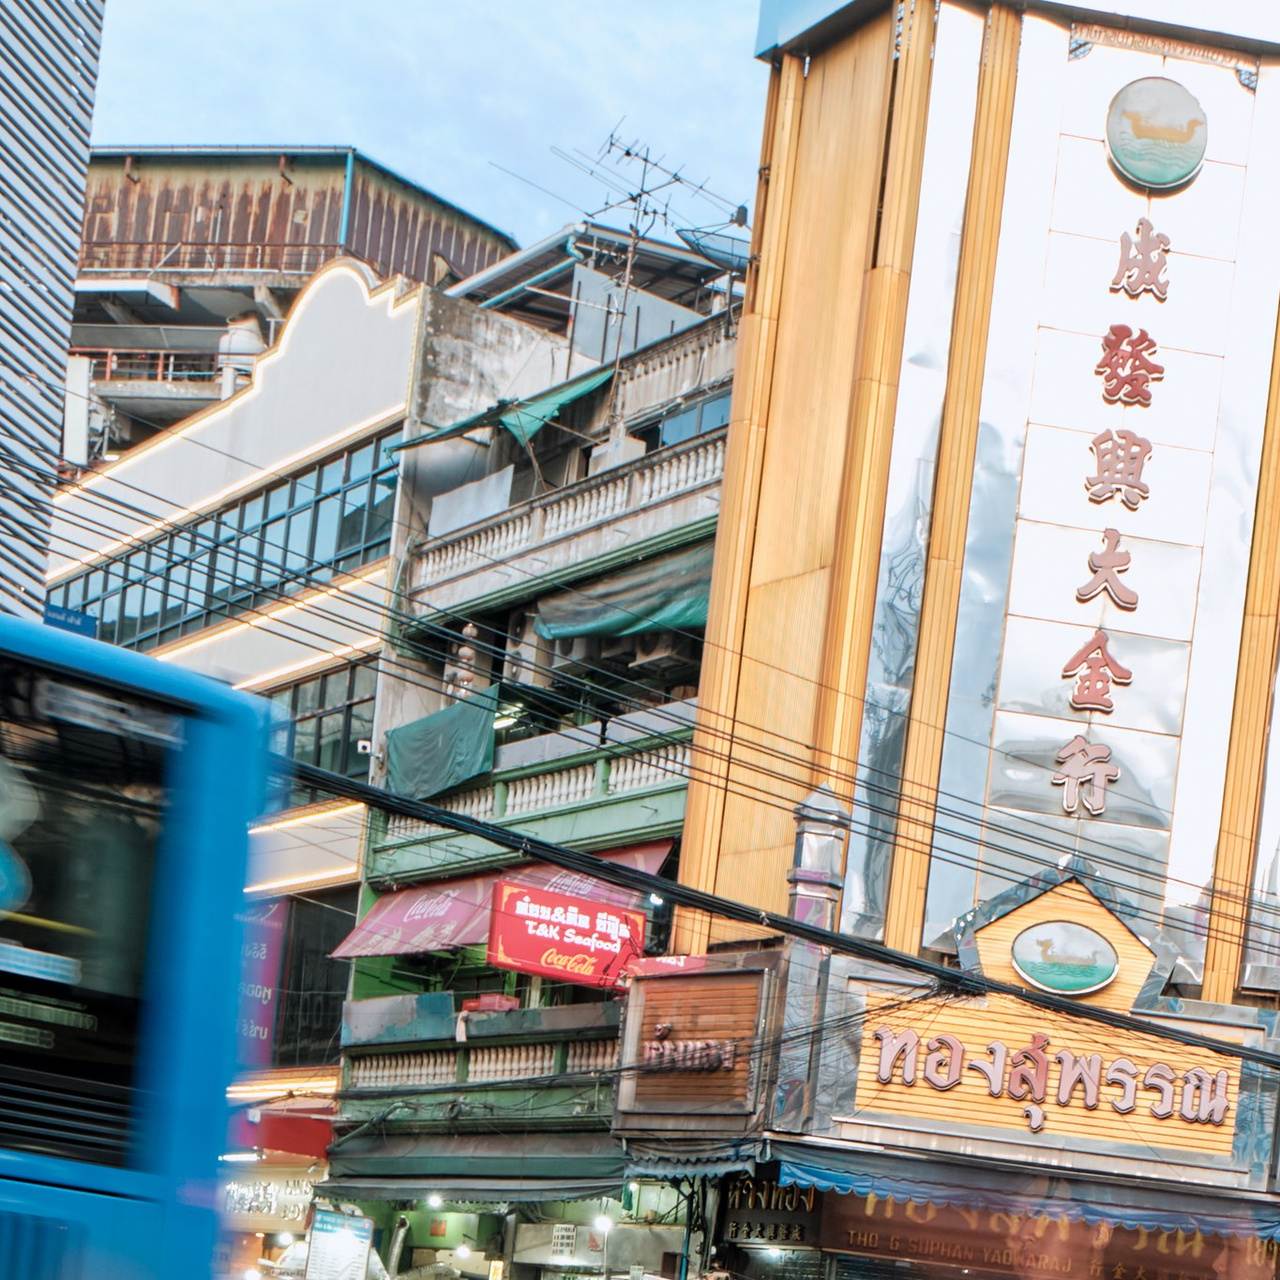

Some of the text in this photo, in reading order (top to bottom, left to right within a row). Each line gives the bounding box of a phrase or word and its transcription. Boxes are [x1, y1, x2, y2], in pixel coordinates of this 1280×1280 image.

[563, 928, 621, 953] Seafood
[871, 1025, 1231, 1134] ทองสุพรรณ
[907, 1238, 974, 1262] SUPHAN
